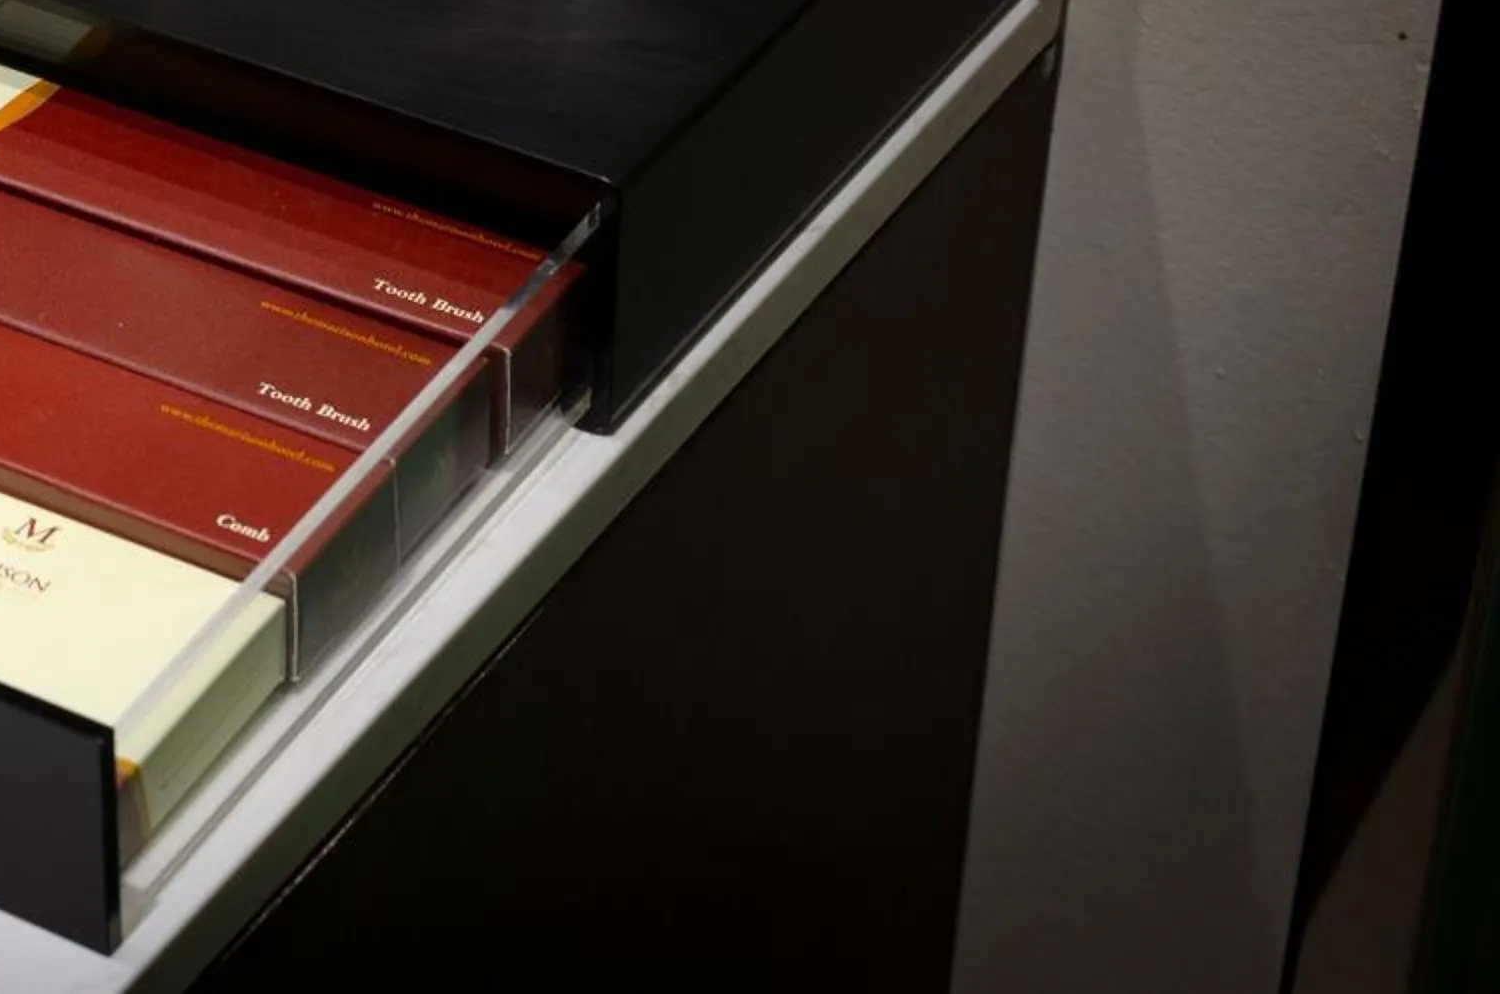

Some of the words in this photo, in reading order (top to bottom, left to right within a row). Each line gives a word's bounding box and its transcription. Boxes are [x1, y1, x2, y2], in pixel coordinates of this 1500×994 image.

[373, 277, 427, 306] Tooth
[432, 297, 486, 325] Brush
[257, 381, 313, 412] Tooth
[315, 402, 373, 433] Brush
[13, 516, 62, 545] M
[215, 513, 272, 544] Comb
